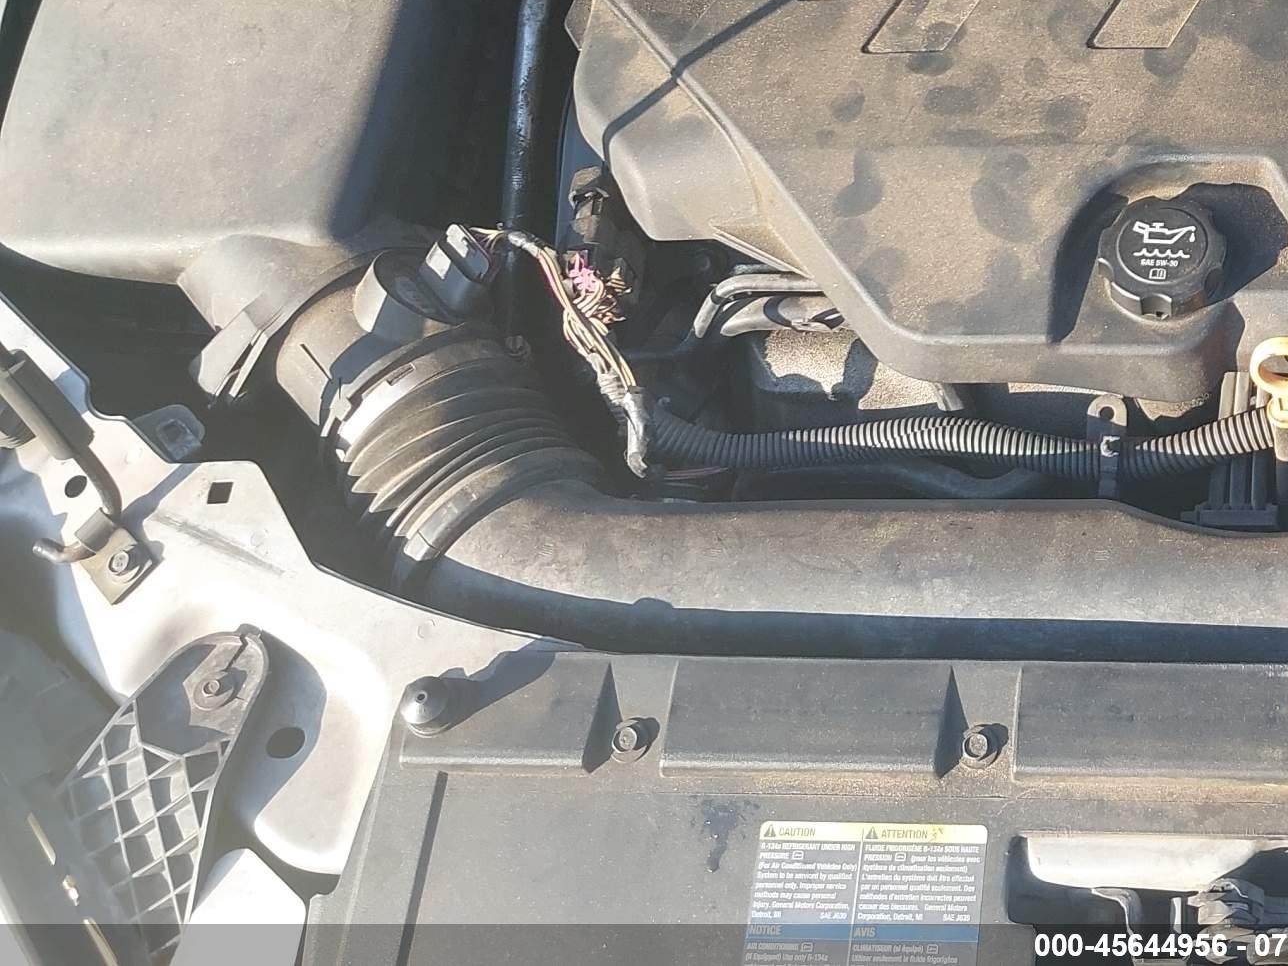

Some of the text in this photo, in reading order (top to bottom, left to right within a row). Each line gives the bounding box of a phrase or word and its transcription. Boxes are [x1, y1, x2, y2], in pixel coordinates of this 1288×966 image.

[1140, 259, 1178, 268] SAE 5W-30
[779, 827, 816, 837] CAUTION
[881, 830, 928, 839] ATTENTION
[749, 925, 781, 935] NOTICE
[855, 927, 876, 937] AVIS
